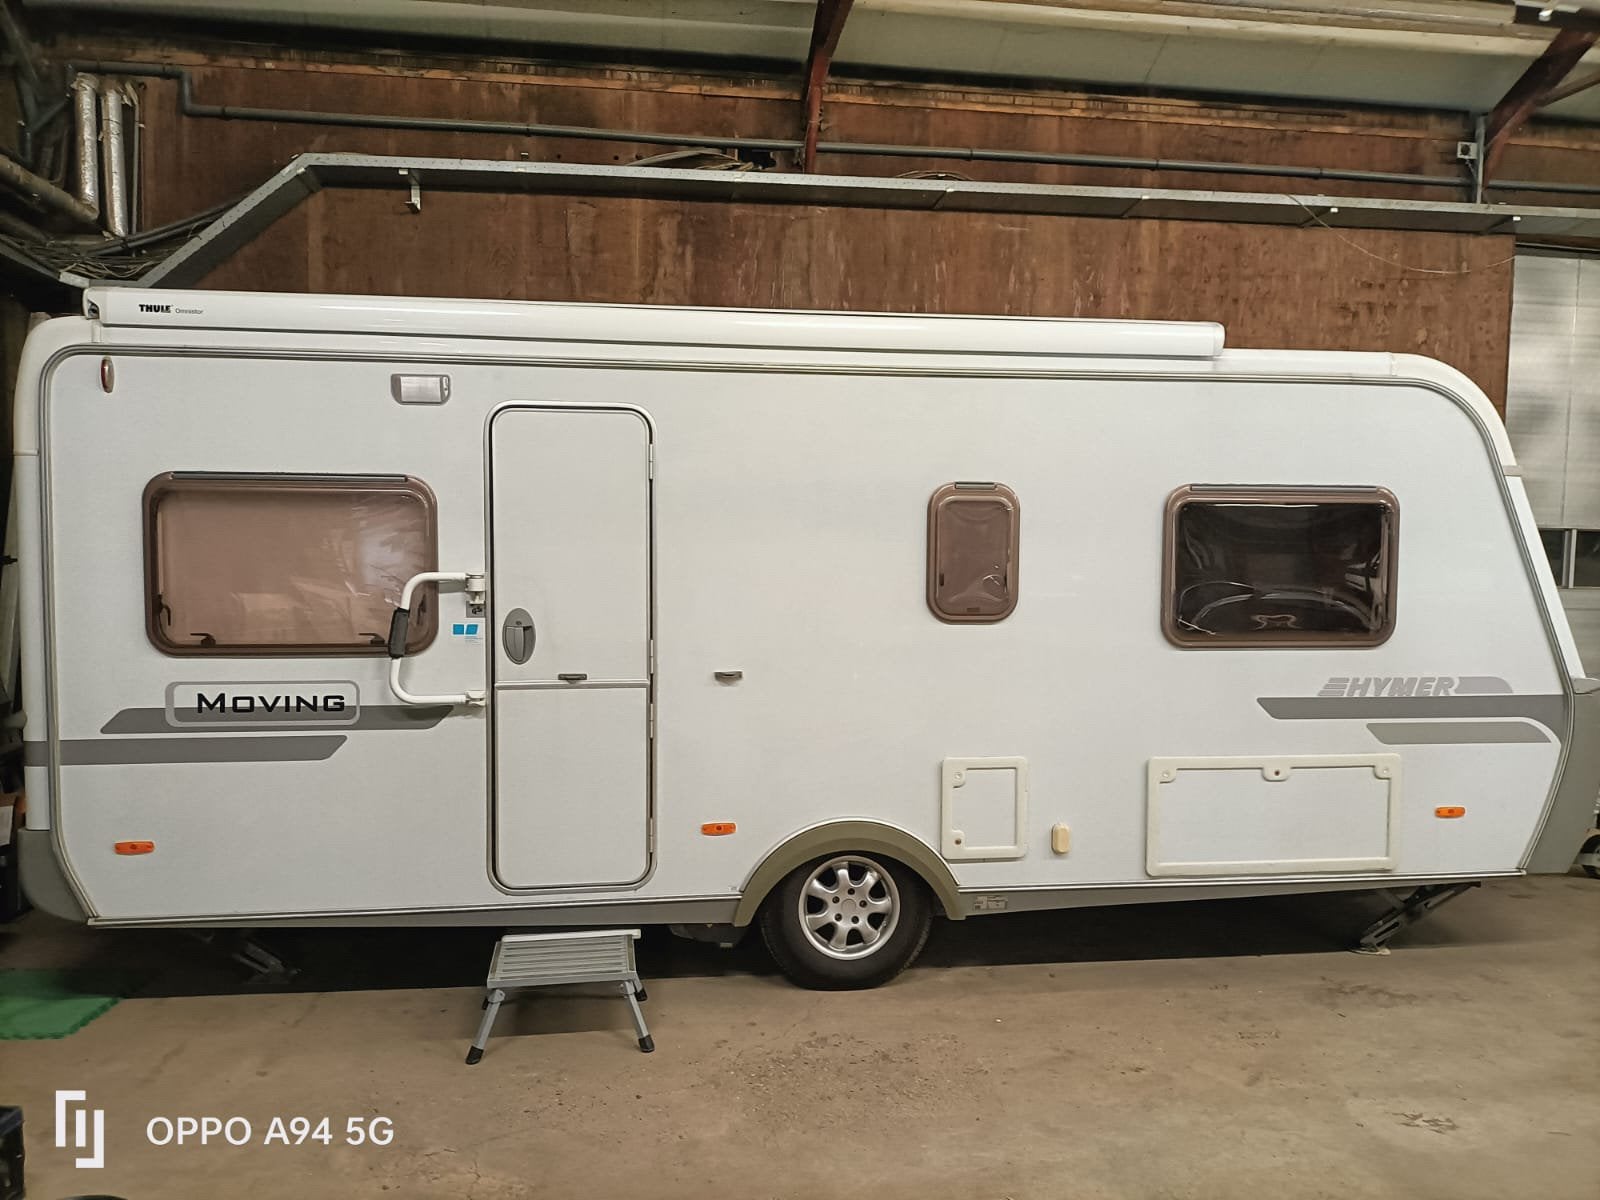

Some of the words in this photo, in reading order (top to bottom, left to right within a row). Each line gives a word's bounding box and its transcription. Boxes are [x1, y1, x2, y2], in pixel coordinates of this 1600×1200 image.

[138, 304, 171, 313] THULE
[1346, 676, 1456, 697] HYMER
[197, 693, 345, 713] MOVING
